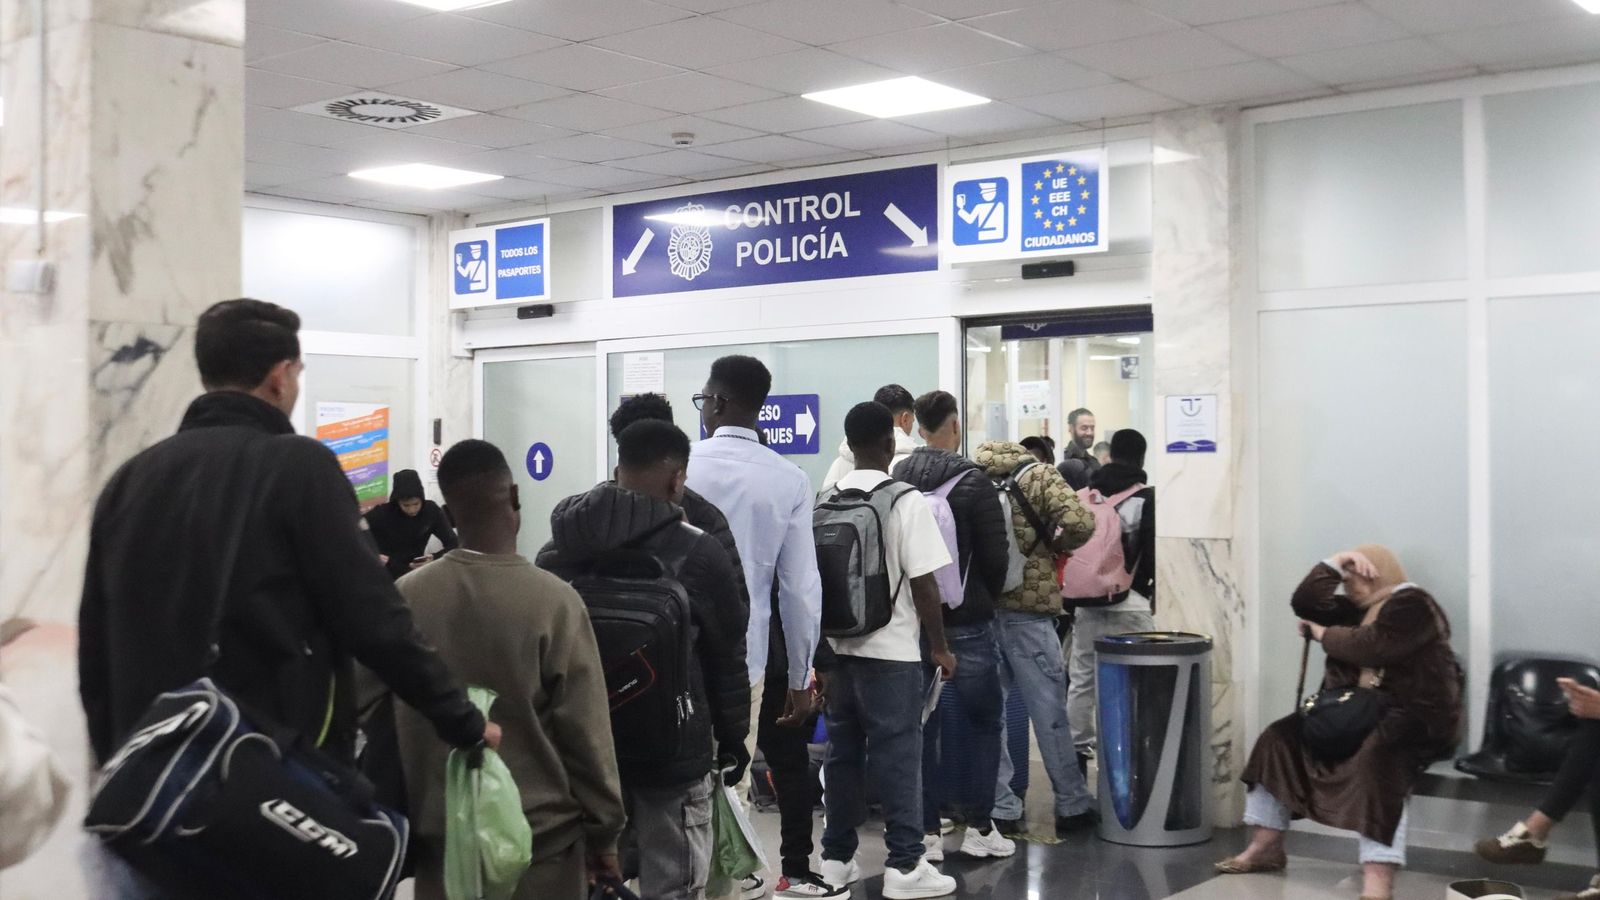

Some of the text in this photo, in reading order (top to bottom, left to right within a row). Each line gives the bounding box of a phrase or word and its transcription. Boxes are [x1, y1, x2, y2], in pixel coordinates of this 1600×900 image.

[1052, 178, 1067, 189] UE
[1049, 191, 1071, 203] EEE
[723, 191, 861, 230] CONTROL
[1052, 205, 1068, 217] CH
[736, 226, 848, 267] POLICÍA
[1024, 232, 1095, 248] CIUDADANOS
[500, 246, 538, 259] TODOS LOS
[497, 265, 541, 278] PASAPORTES
[758, 404, 780, 421] ESO
